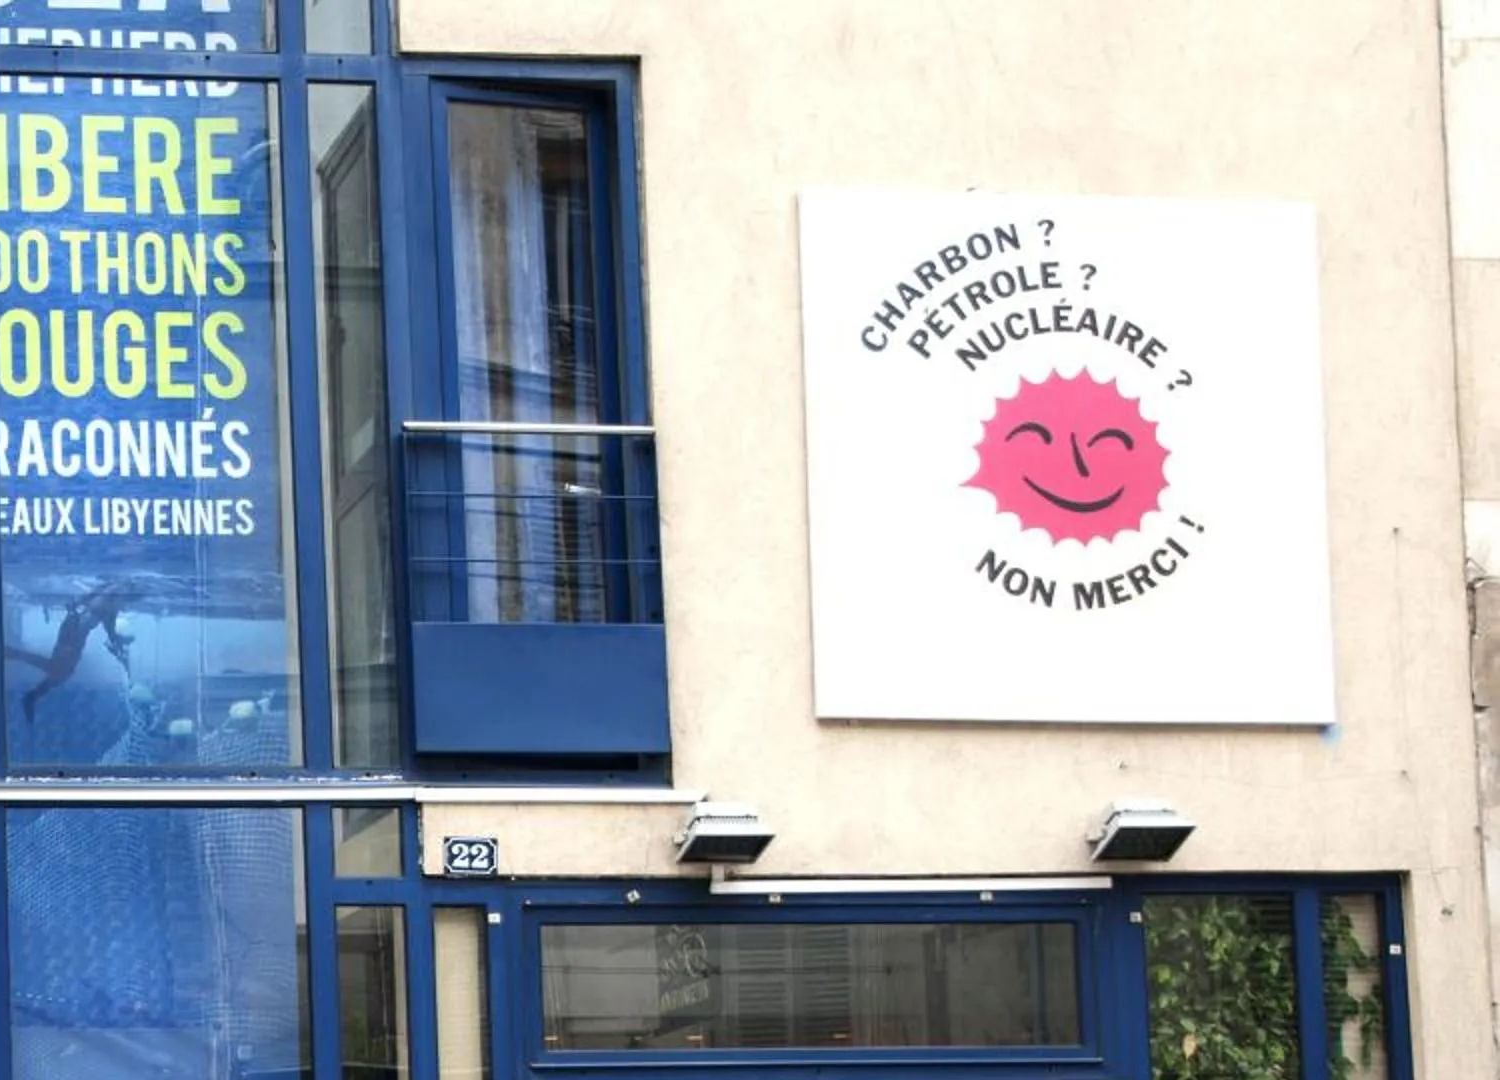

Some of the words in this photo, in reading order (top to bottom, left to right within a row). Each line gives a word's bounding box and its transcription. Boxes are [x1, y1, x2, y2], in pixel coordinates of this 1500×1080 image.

[59, 230, 246, 298] THONS
[860, 224, 1021, 353] CHARBON
[1037, 219, 1055, 247] ?
[906, 261, 1062, 359] PÉTROLE
[1079, 263, 1097, 290] ?
[955, 298, 1169, 371] NUCLÉAIRE
[1167, 369, 1193, 392] ?
[84, 498, 254, 536] LIBYENNES
[975, 549, 1057, 607] NON
[1073, 536, 1189, 611] MERCI
[1179, 514, 1205, 534] !
[451, 843, 489, 869] 22
